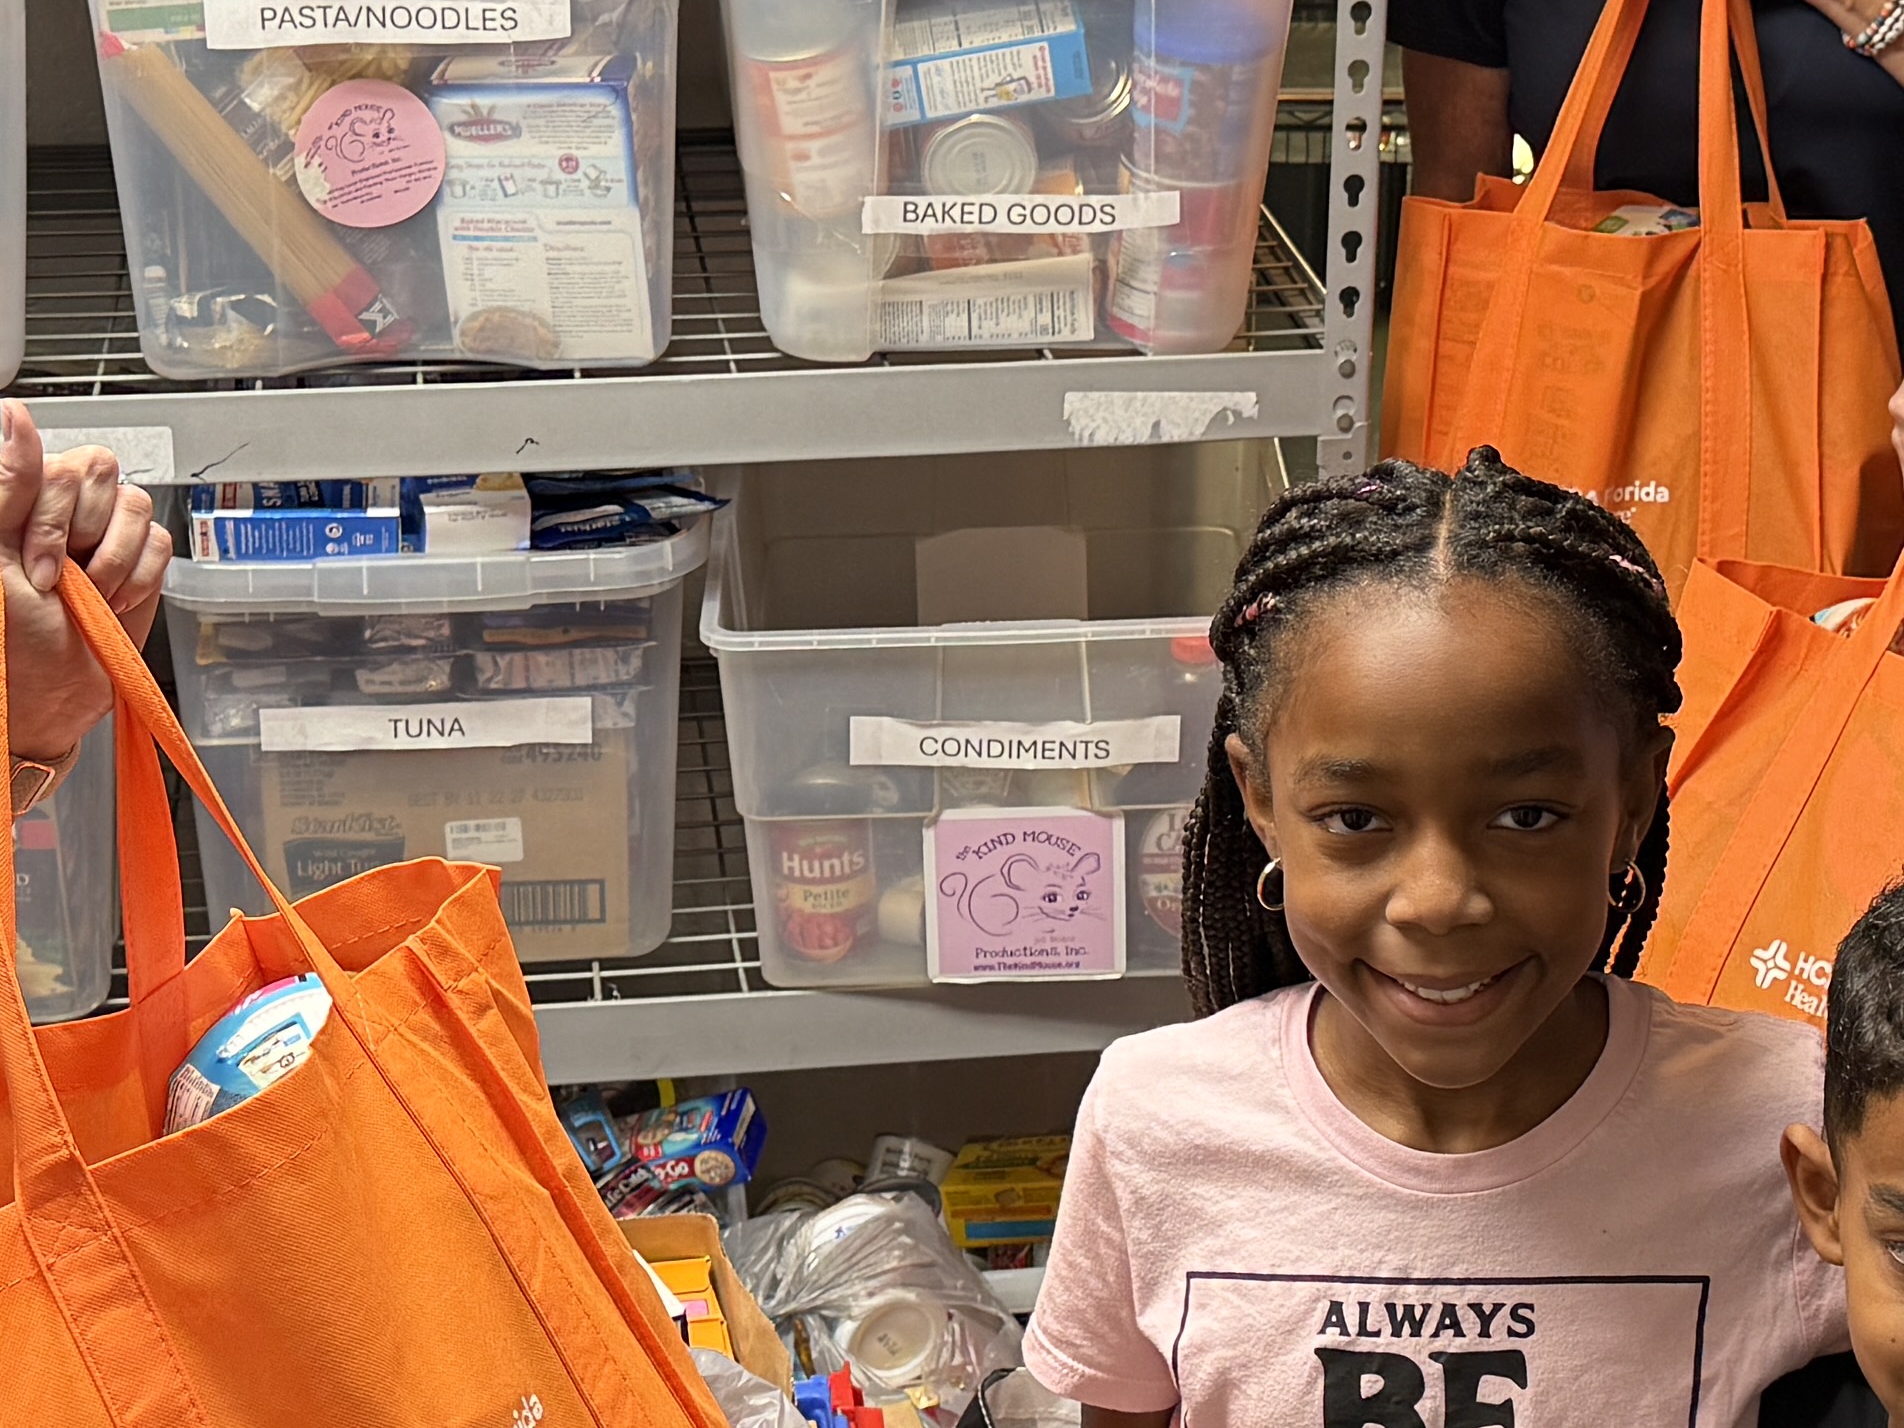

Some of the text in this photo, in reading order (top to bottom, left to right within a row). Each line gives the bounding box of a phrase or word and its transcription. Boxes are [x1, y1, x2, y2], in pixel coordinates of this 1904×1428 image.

[259, 5, 519, 33] PASTA/NOODLES
[901, 202, 1117, 228] BAKED GOODS
[387, 717, 466, 740] TUNA
[918, 735, 1111, 762] CONDIMENTS
[972, 830, 1017, 861] KIND
[1022, 830, 1082, 858] MOUSE
[802, 886, 851, 903] Petite
[1794, 950, 1834, 989] HC
[1317, 1301, 1536, 1340] ALWAYS
